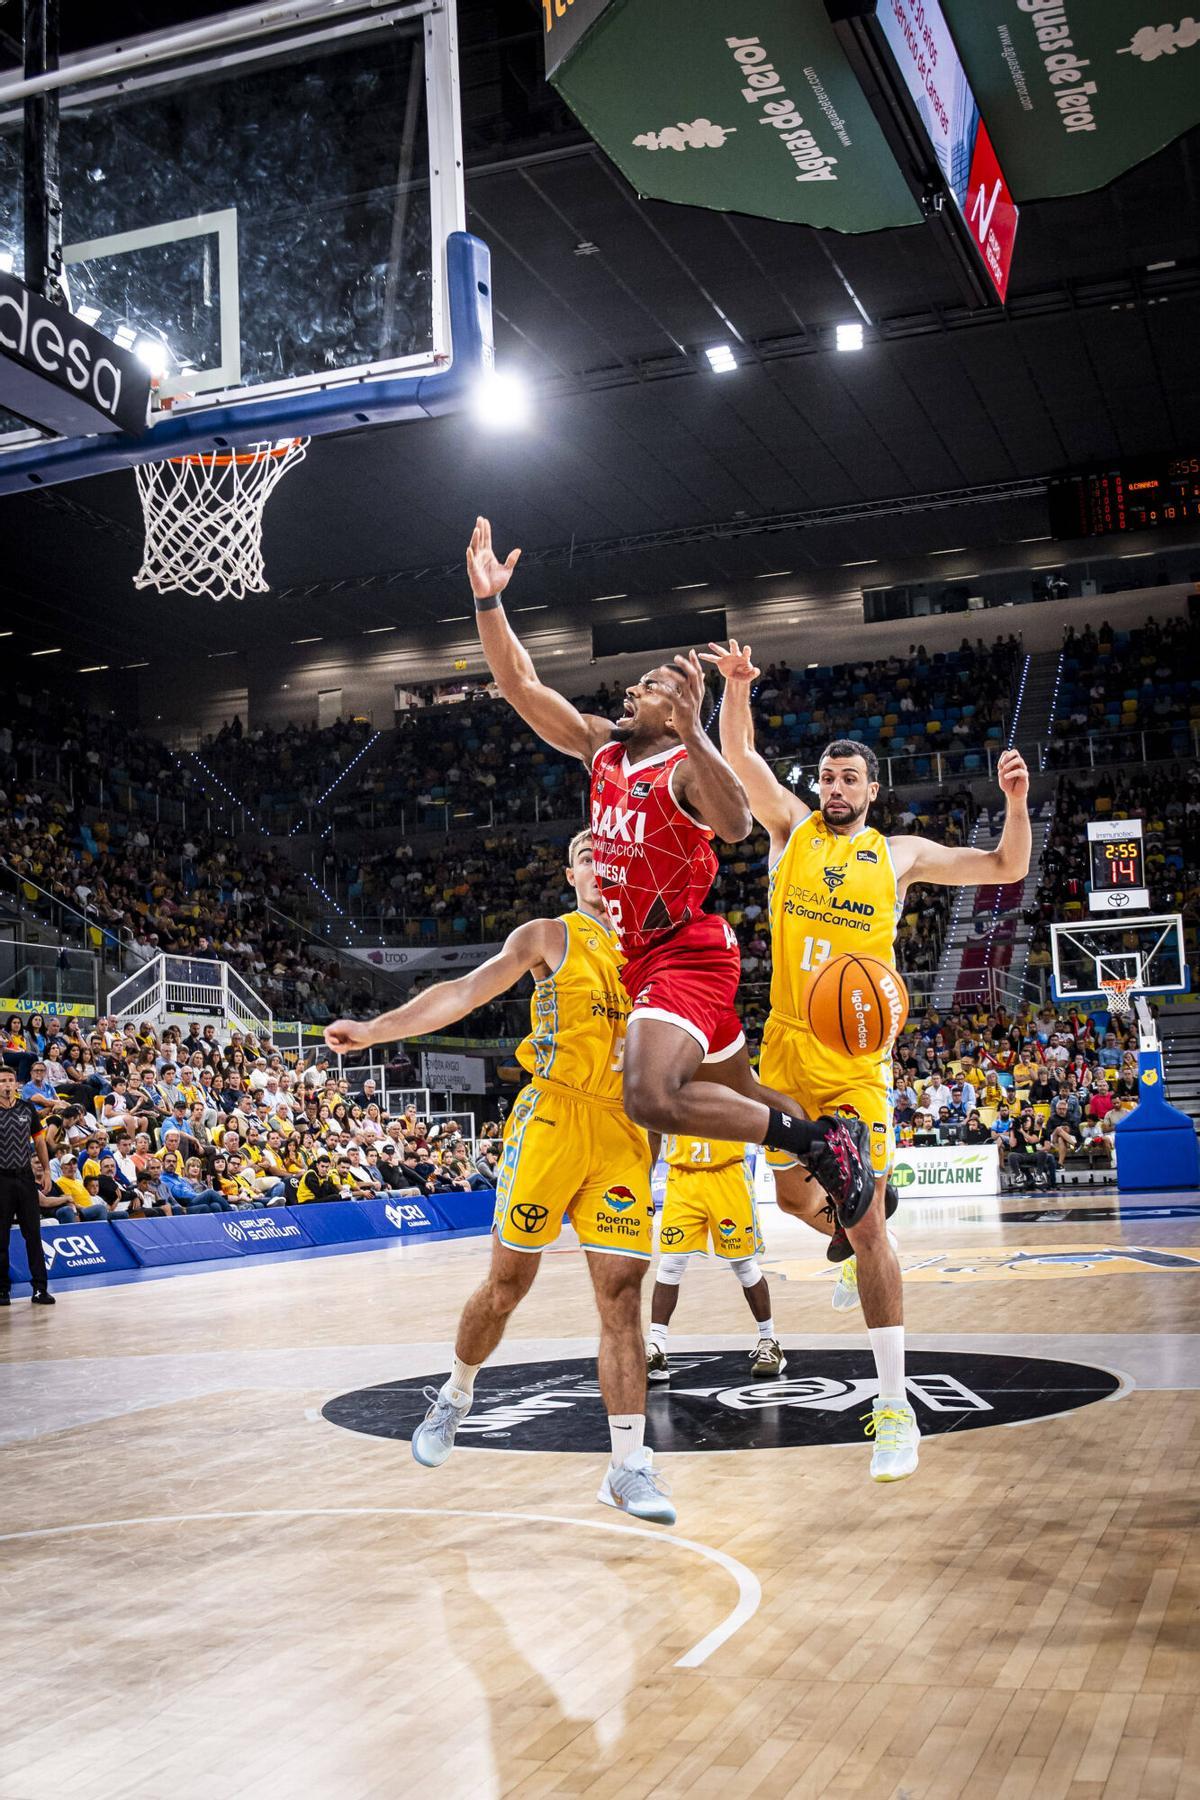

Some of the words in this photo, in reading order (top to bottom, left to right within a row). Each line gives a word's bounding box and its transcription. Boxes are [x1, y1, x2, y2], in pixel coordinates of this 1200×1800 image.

[1017, 0, 1074, 52] guas
[725, 36, 786, 103] Teror
[996, 24, 1034, 111] www.aguasdeteror.com
[1044, 52, 1090, 86] de
[758, 99, 804, 130] de
[802, 66, 853, 148] www.aguasdeteror.com
[926, 68, 949, 136] Canarias
[1053, 81, 1098, 133] Teror
[779, 129, 838, 182] Aguas
[592, 800, 647, 844] BAXI
[1105, 843, 1138, 859] 2:55
[1112, 860, 1135, 883] 14
[786, 884, 875, 917] DREAMLAND
[795, 905, 871, 932] GranCanaria
[385, 952, 408, 963] trop
[800, 935, 832, 972] 13
[851, 989, 863, 1011] liga
[690, 1142, 711, 1163] 21
[917, 1161, 948, 1169] GRUPO
[239, 1218, 275, 1229] GRUPO
[396, 1204, 425, 1220] CRI
[596, 1212, 640, 1227] Poema
[597, 1224, 613, 1234] del
[617, 1225, 640, 1237] Mar
[53, 1235, 100, 1257] CRI
[66, 1256, 106, 1267] CANARIAS
